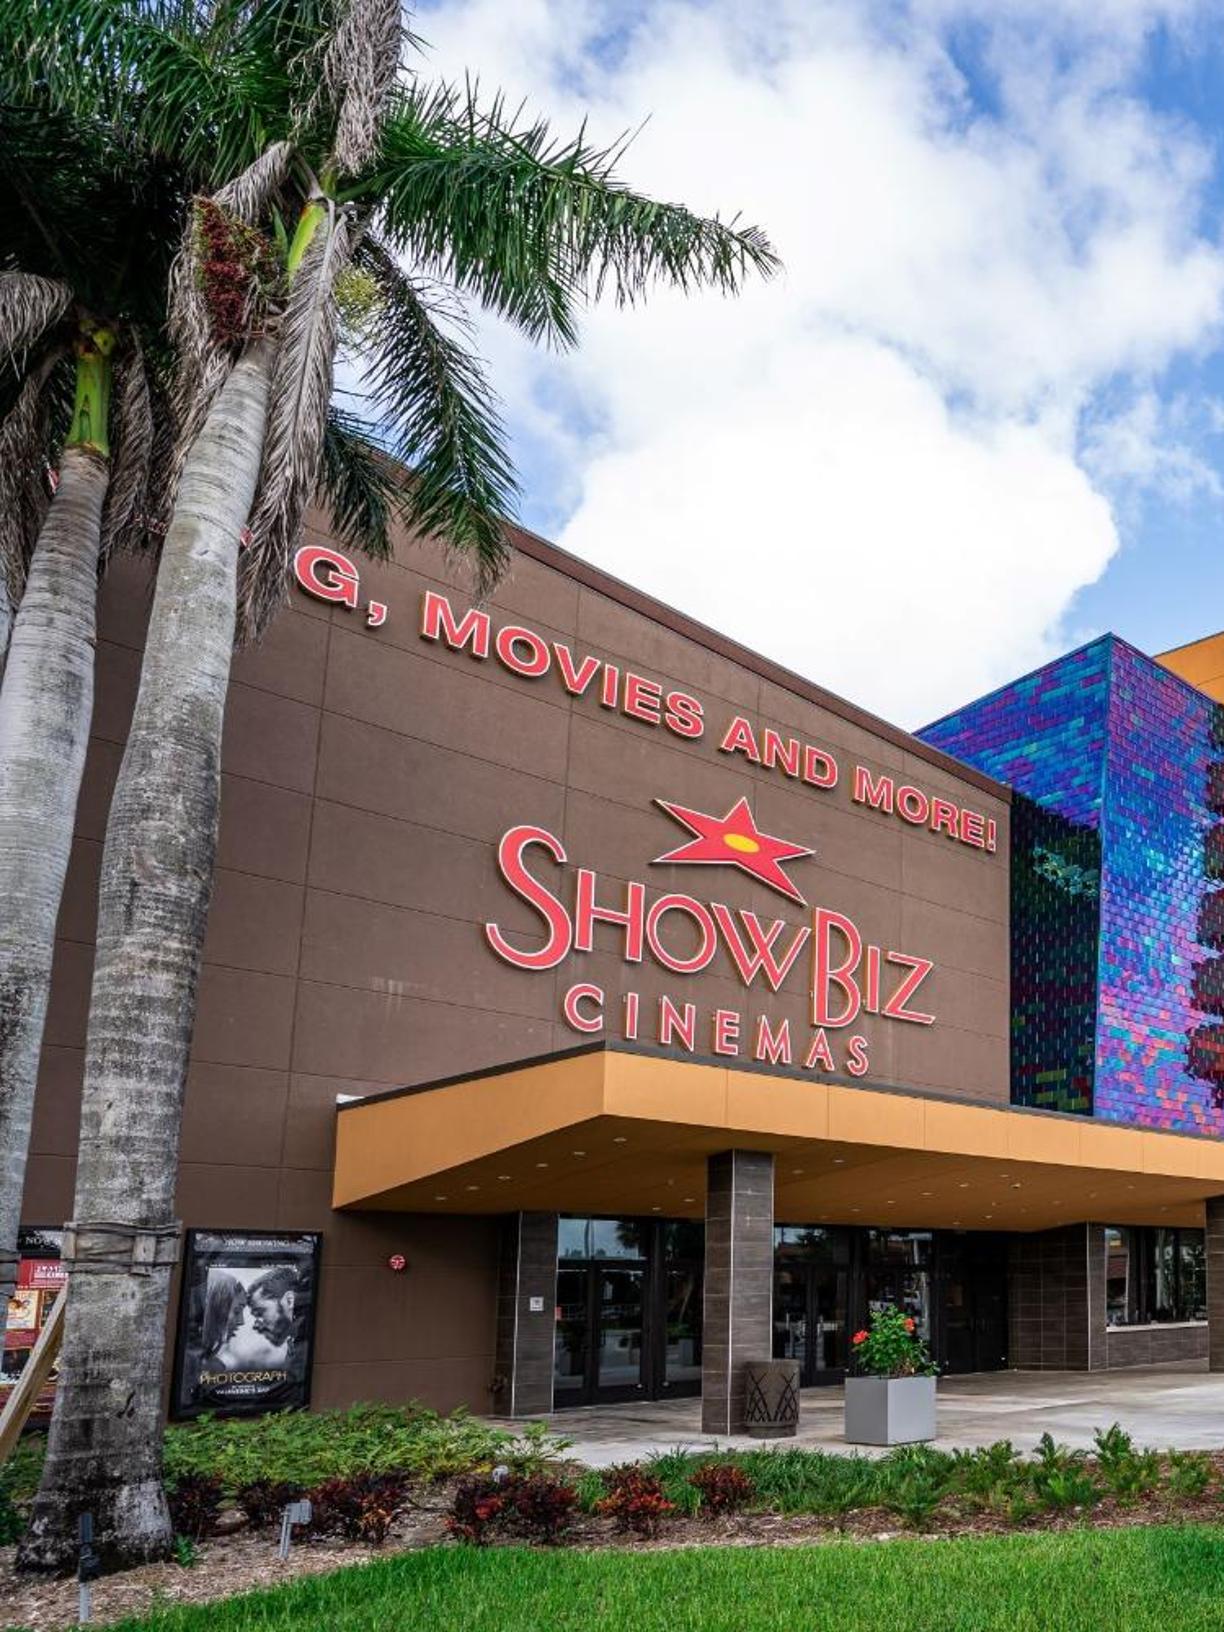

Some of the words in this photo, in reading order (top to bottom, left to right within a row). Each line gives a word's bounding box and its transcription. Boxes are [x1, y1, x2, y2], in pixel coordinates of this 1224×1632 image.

[422, 590, 706, 739] MOVIES
[720, 715, 839, 790] AND
[852, 765, 998, 853] MORE!
[563, 983, 870, 1076] CINEMAS
[199, 1371, 287, 1385] PHOTOGRAPH
